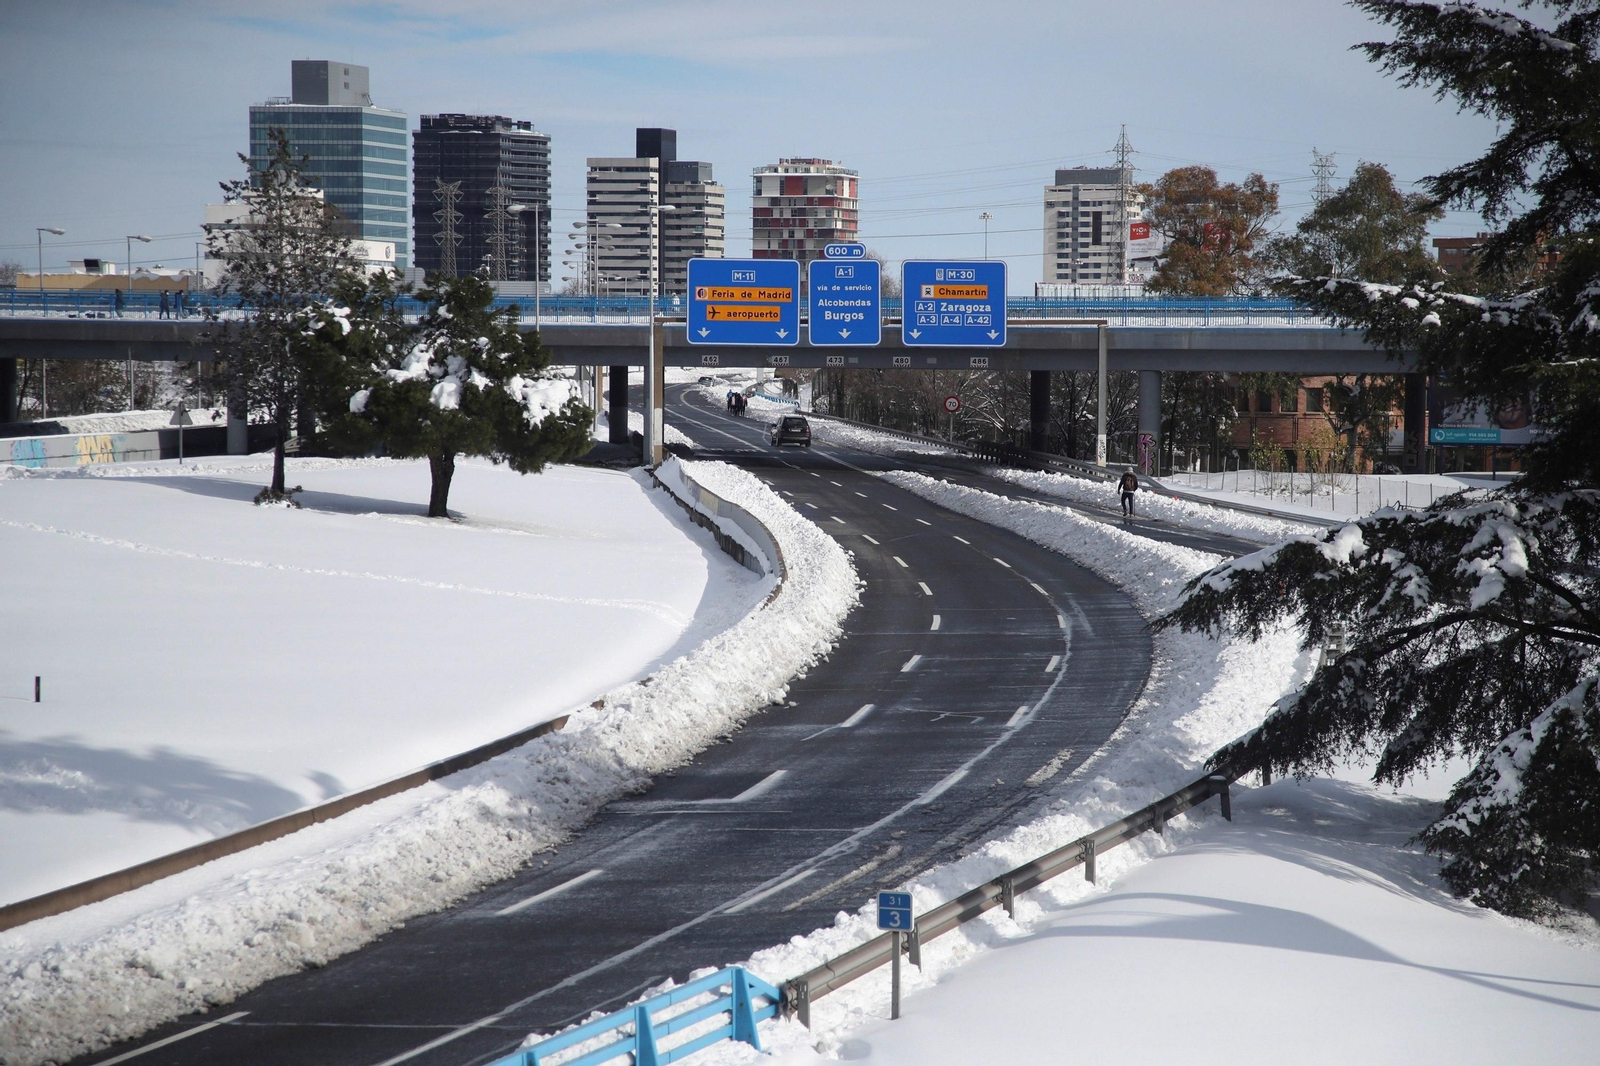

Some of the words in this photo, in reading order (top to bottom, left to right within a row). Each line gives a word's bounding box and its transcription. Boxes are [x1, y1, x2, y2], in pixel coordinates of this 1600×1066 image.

[828, 247, 848, 255] 600
[734, 272, 754, 281] M-11
[837, 268, 852, 276] A-1
[948, 271, 973, 279] M-30
[711, 289, 735, 298] Feria
[740, 290, 752, 298] de
[758, 290, 791, 299] Madrid
[817, 298, 872, 307] Alcobendas
[917, 303, 934, 311] A-2
[940, 302, 991, 314] Zaragoza
[726, 310, 779, 319] aeropuerto
[824, 310, 864, 322] Burgos
[919, 315, 936, 324] A-3
[943, 315, 960, 324] A-4
[966, 316, 989, 324] A-42
[889, 896, 901, 905] 31
[889, 910, 901, 928] 3
